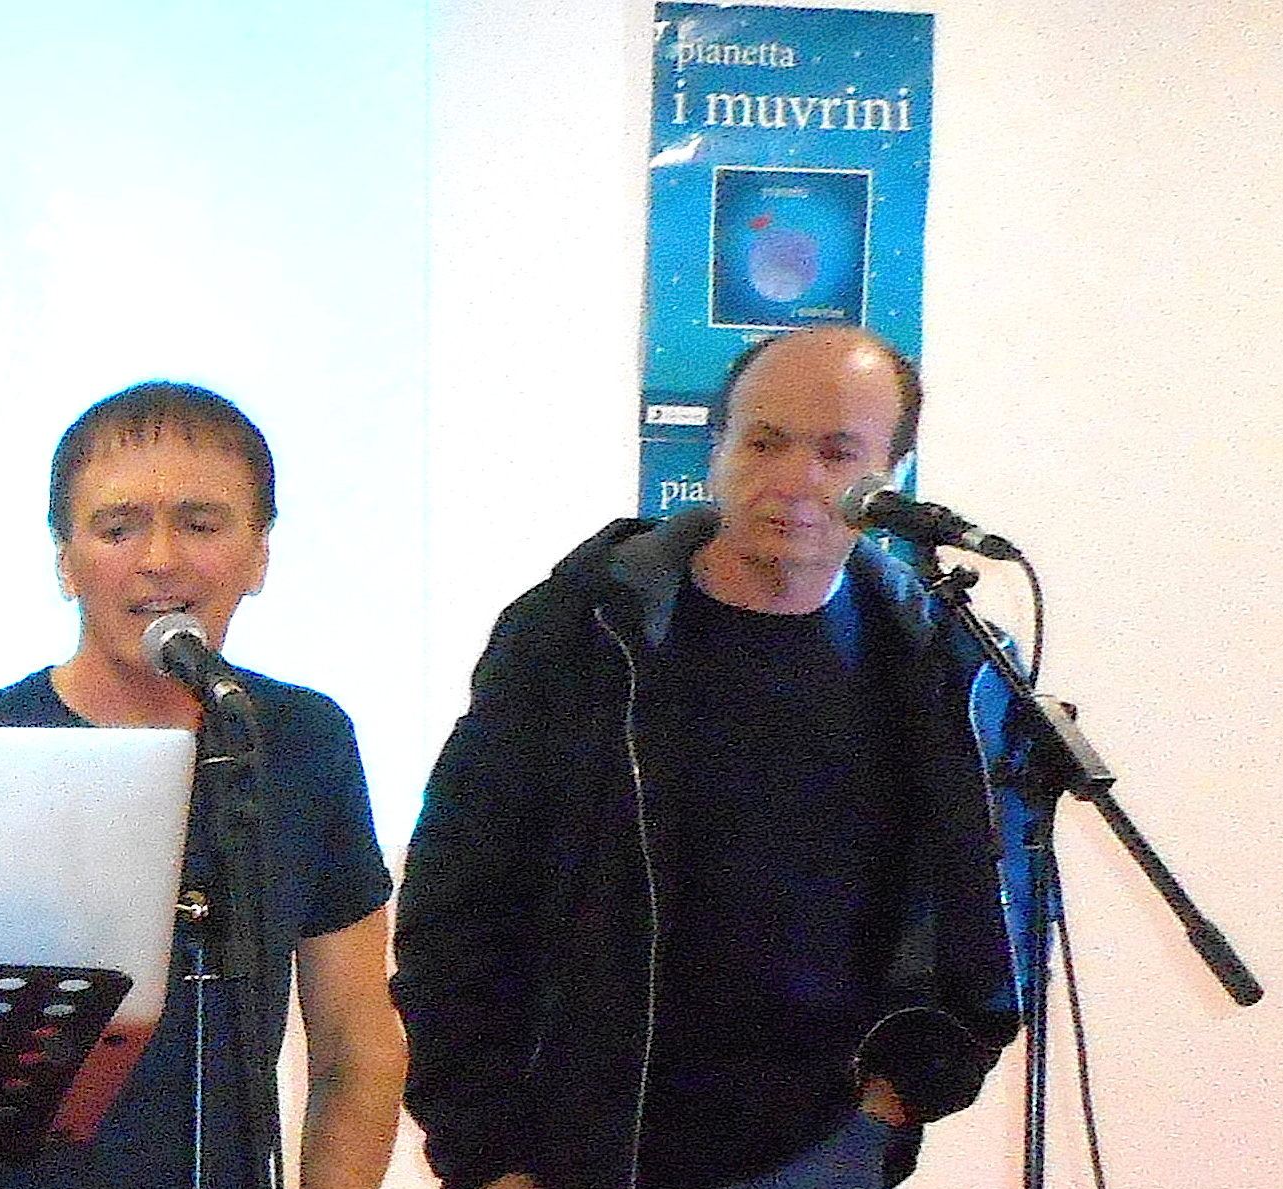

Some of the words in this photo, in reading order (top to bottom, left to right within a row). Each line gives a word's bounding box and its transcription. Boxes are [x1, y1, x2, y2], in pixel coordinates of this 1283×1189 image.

[677, 42, 799, 72] pianetta
[671, 78, 688, 125] i
[704, 86, 912, 132] muvrini
